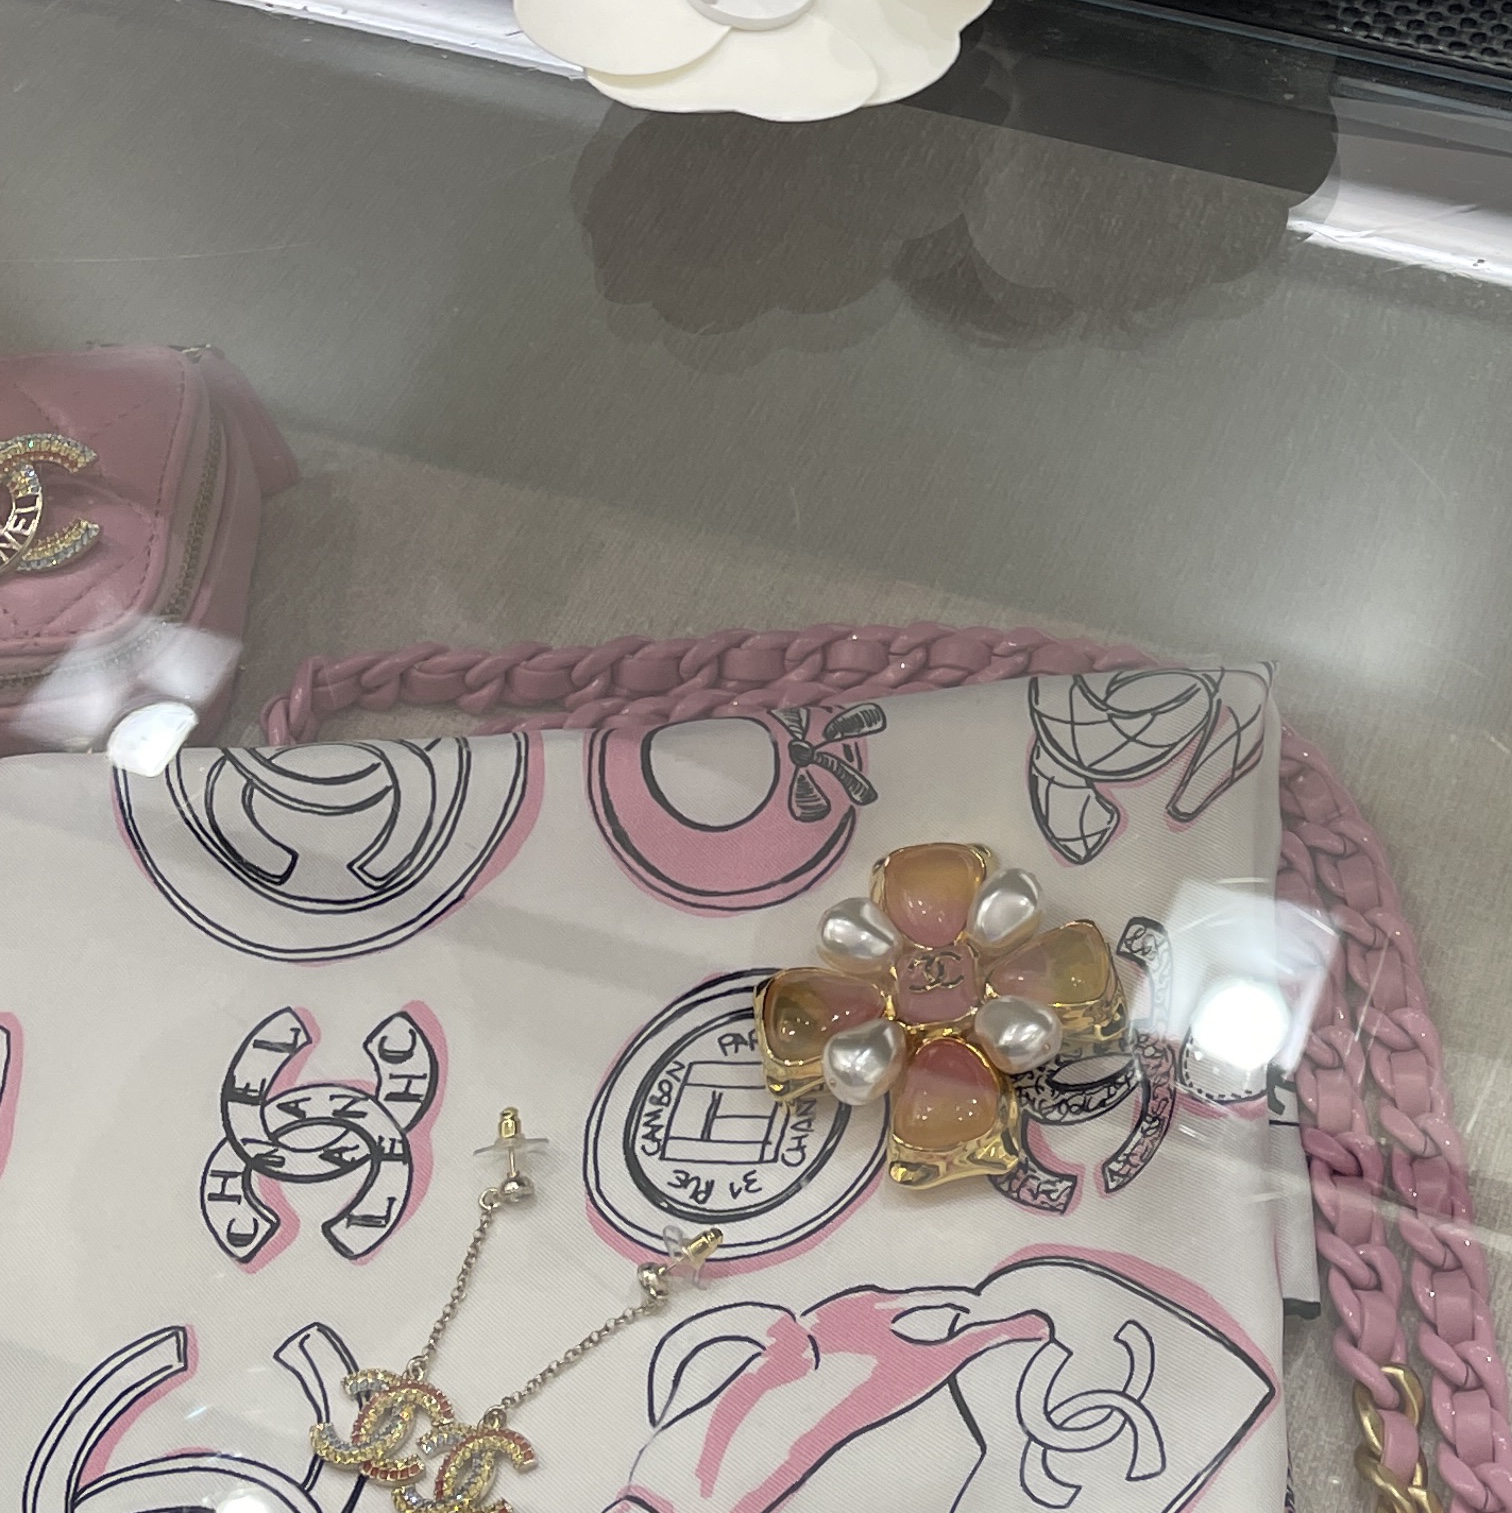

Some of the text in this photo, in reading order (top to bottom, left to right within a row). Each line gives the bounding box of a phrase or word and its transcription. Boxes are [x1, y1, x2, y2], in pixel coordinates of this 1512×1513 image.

[640, 1061, 688, 1157] CAMBON
[781, 1097, 817, 1168] CHAN
[667, 1169, 715, 1205] RUE
